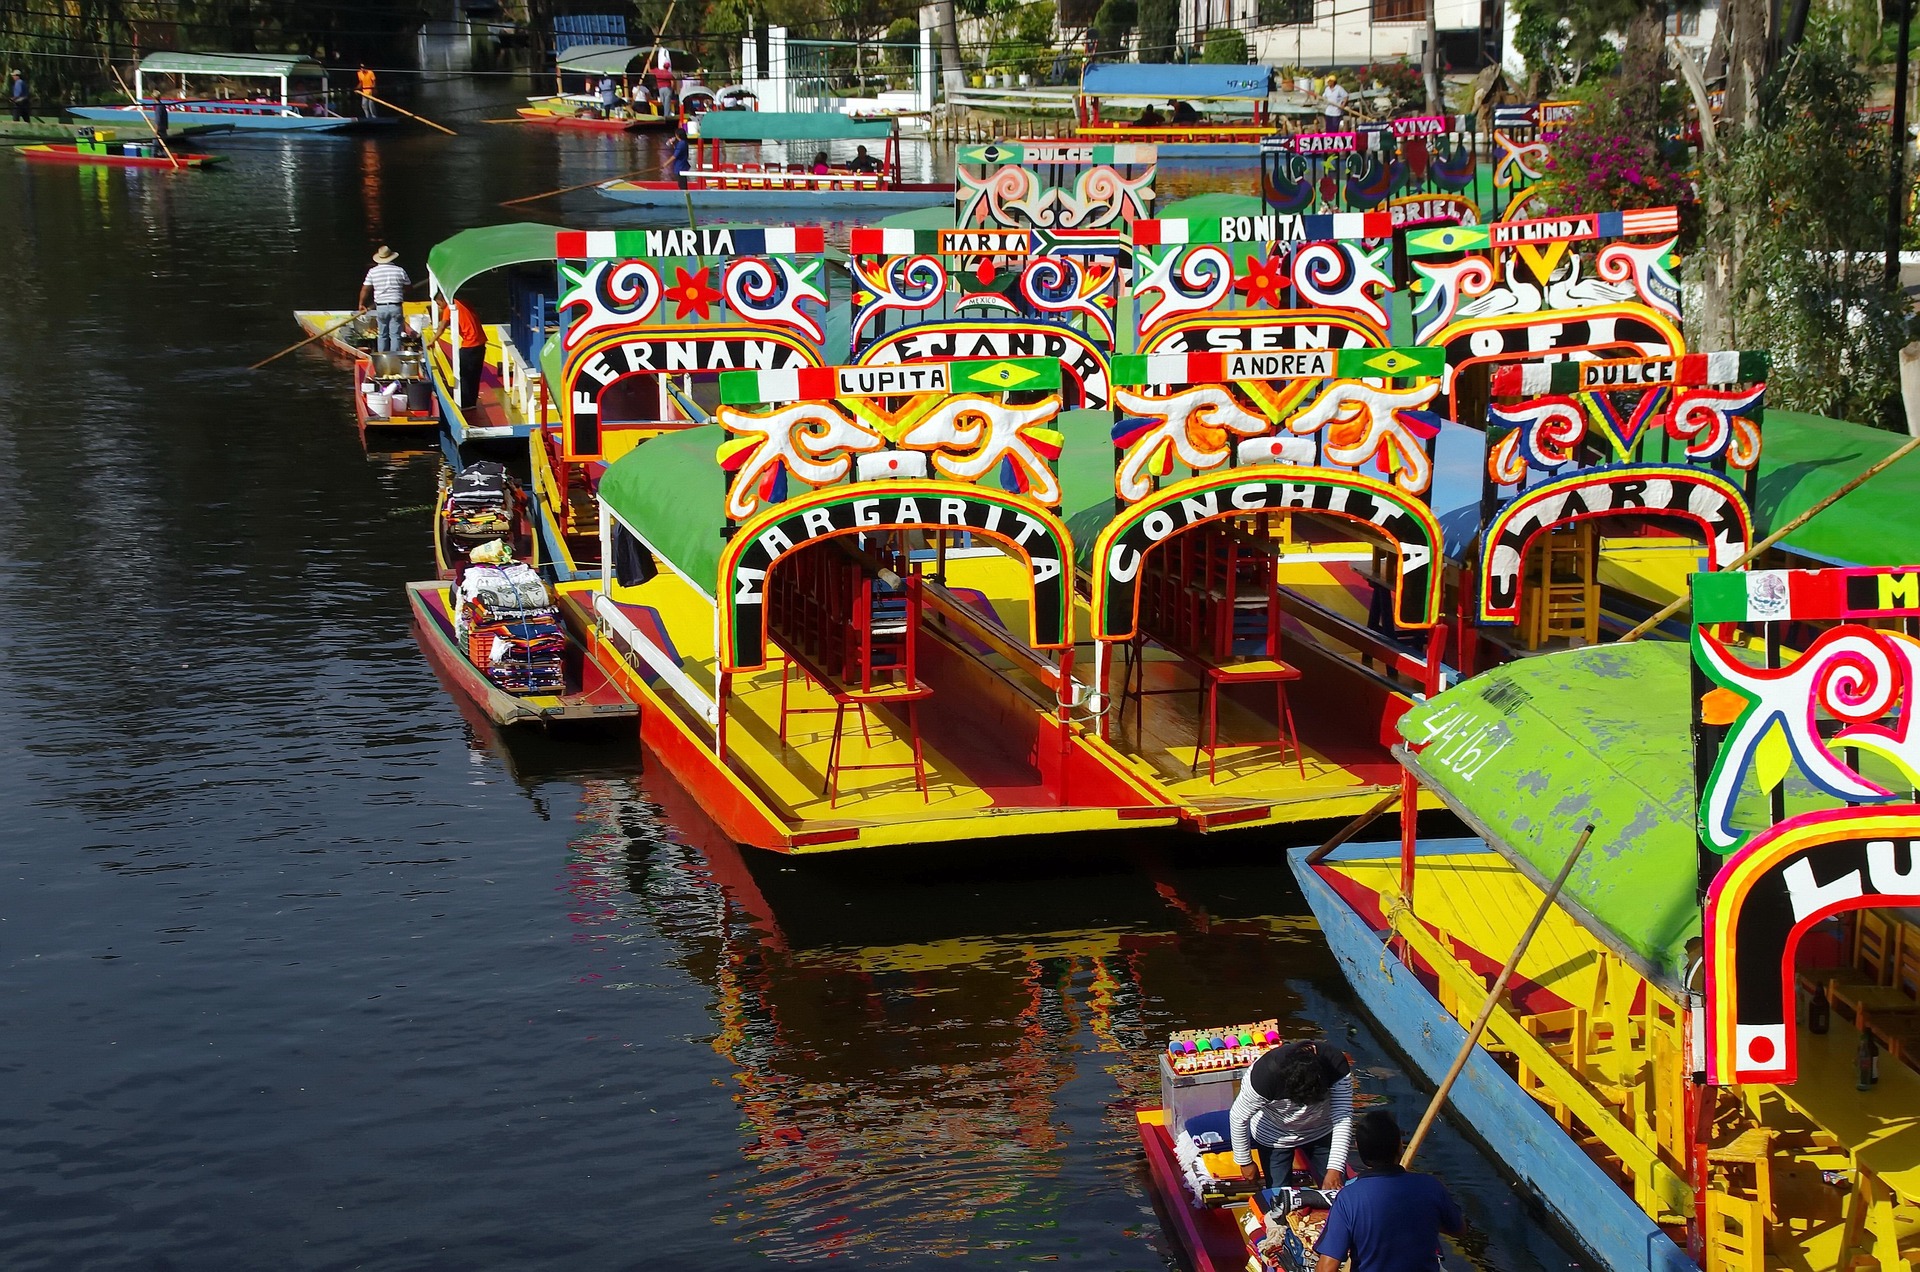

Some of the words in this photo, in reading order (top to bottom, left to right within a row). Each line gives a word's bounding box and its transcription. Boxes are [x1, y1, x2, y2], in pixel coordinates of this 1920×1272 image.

[1395, 119, 1441, 133] VIVA
[1023, 147, 1092, 161] DULCE
[1299, 136, 1352, 151] SARAI
[1389, 200, 1476, 226] BRIELA
[1221, 215, 1306, 243] BONITA
[1496, 226, 1519, 243] MI
[1523, 219, 1592, 240] LINDA
[645, 229, 735, 257] MARIA
[943, 233, 1027, 251] MARIA
[968, 297, 997, 305] MEXICO
[893, 333, 1108, 410] EJANDRA
[1232, 353, 1325, 376] ANDREA
[1586, 360, 1674, 385] DULCE
[841, 369, 945, 393] LUPITA
[1109, 483, 1431, 583] CONCHITA
[1490, 478, 1746, 608] CLARIT
[735, 497, 1060, 604] MARGARITA
